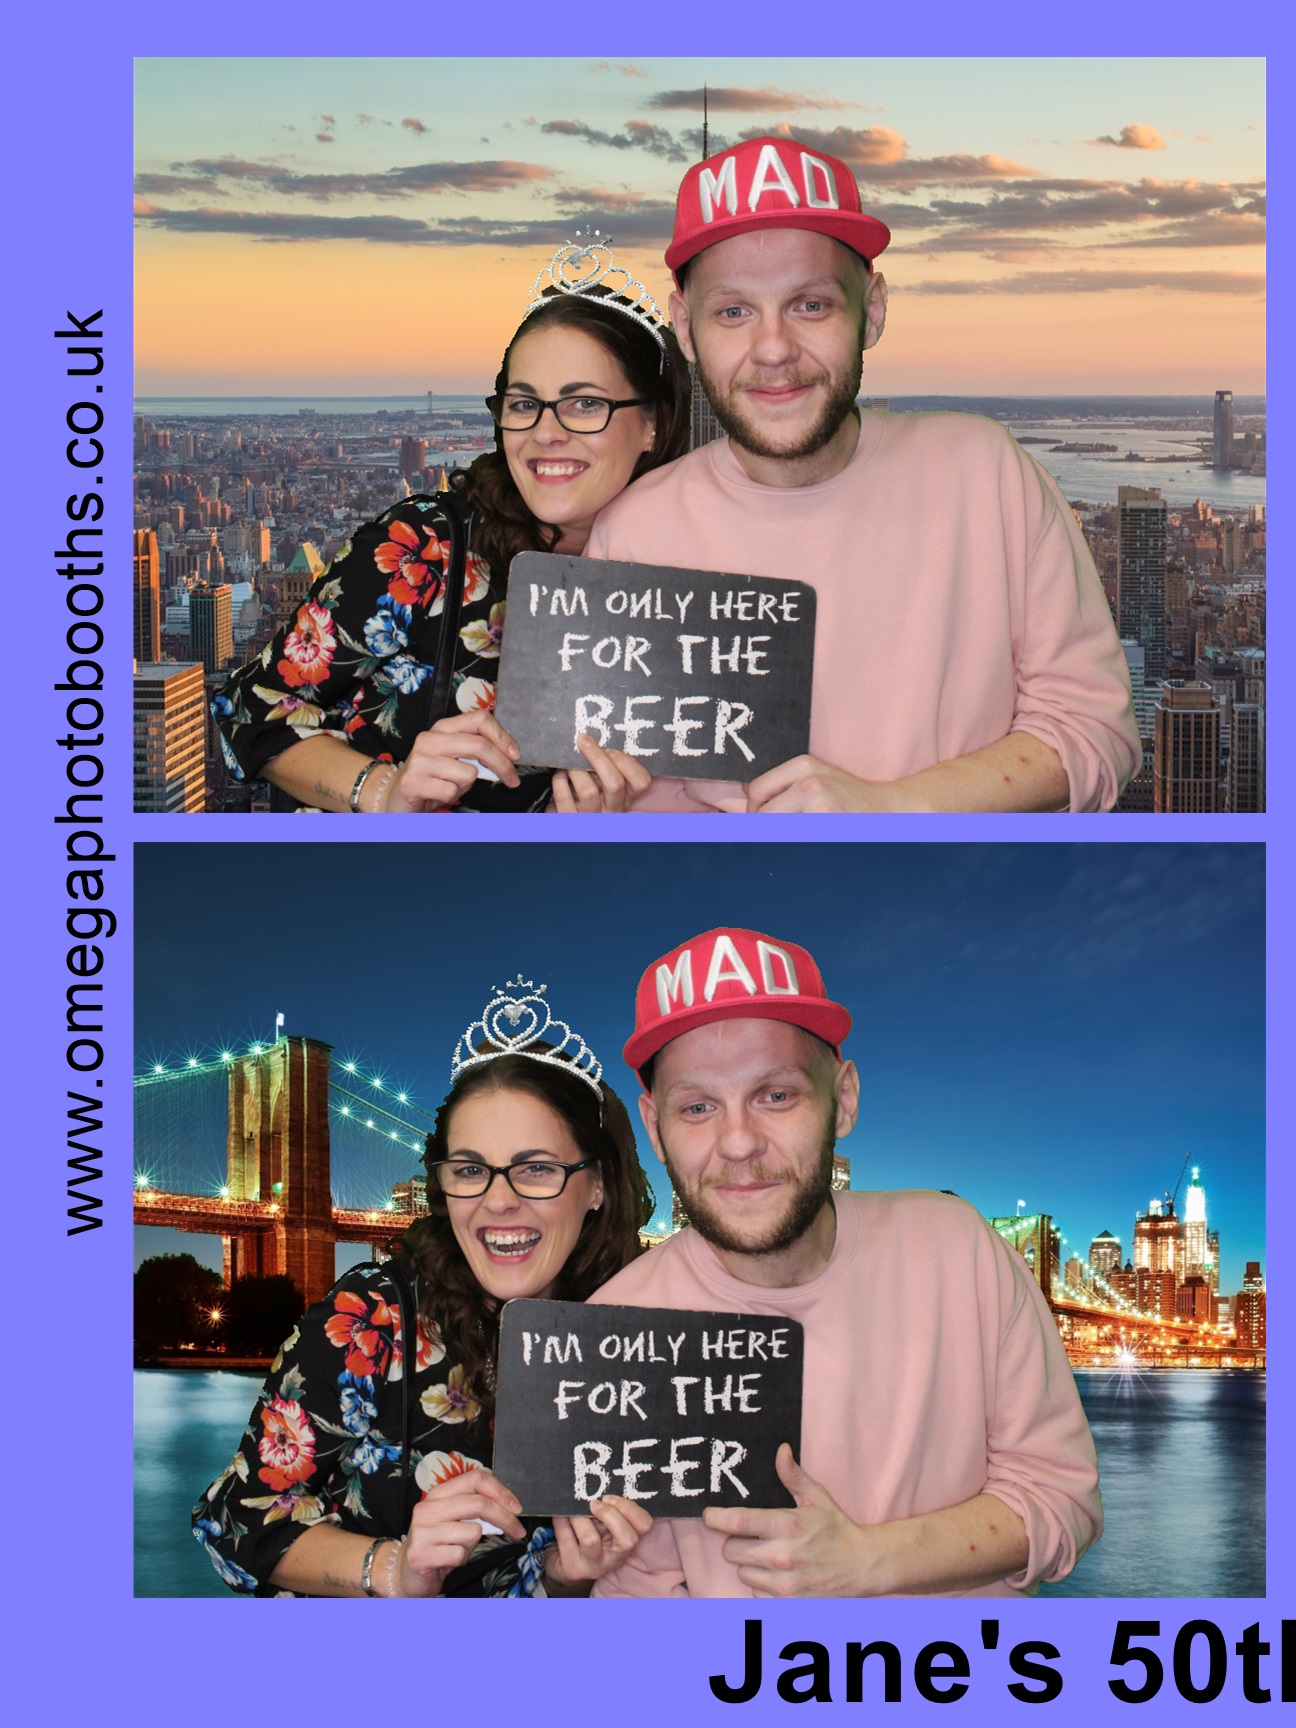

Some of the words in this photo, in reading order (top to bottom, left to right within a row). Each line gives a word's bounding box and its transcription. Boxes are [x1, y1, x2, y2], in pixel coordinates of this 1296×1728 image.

[699, 145, 840, 224] MAD
[529, 583, 590, 617] I'M
[605, 587, 694, 624] ONLY
[709, 590, 801, 624] HERE
[556, 631, 652, 677] FOR
[676, 634, 771, 676] THE
[572, 693, 757, 763] BEER
[655, 935, 800, 1017] MAD
[522, 1331, 583, 1366] I'M
[598, 1330, 686, 1366] ONLY
[701, 1328, 789, 1361] HERE
[553, 1379, 648, 1421] FOR
[670, 1373, 762, 1416] THE
[573, 1436, 750, 1501] BEER
